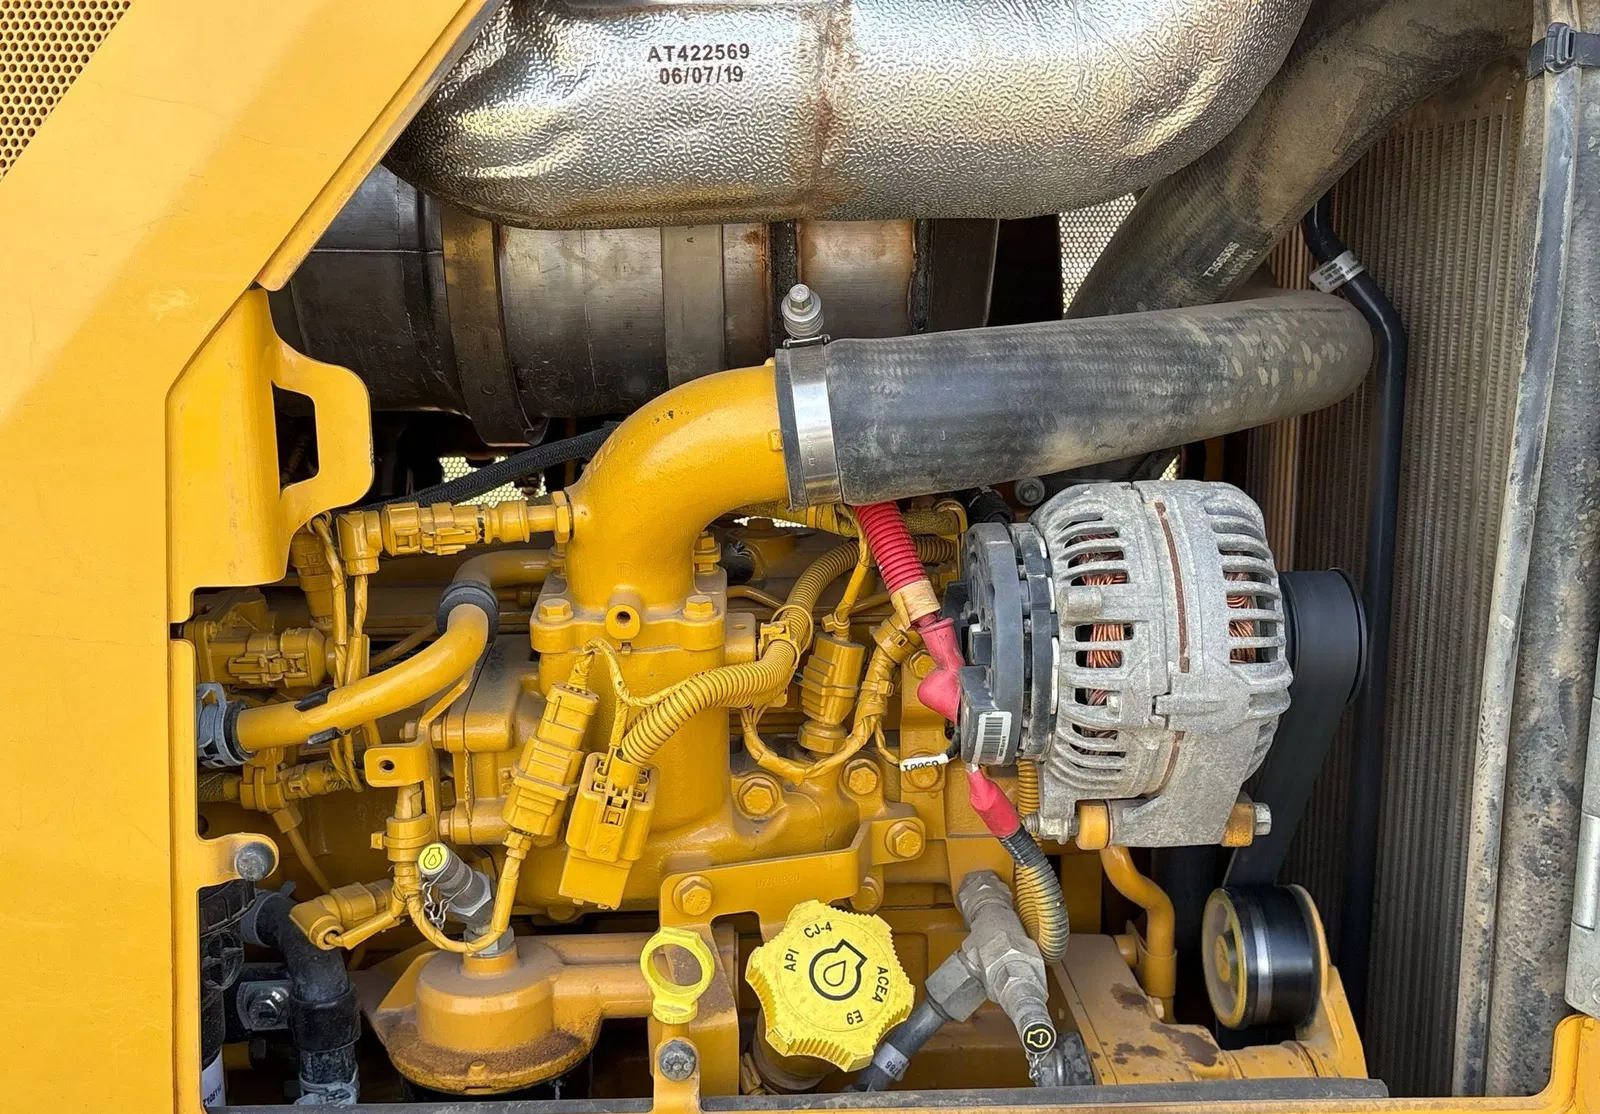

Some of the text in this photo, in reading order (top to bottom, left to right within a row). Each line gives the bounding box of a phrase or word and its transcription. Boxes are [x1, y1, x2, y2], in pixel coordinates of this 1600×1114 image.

[647, 43, 750, 62] AT422569
[659, 65, 744, 85] 06/07/19
[784, 921, 833, 972] API CJ-4
[846, 965, 890, 1025] ACEA E9
